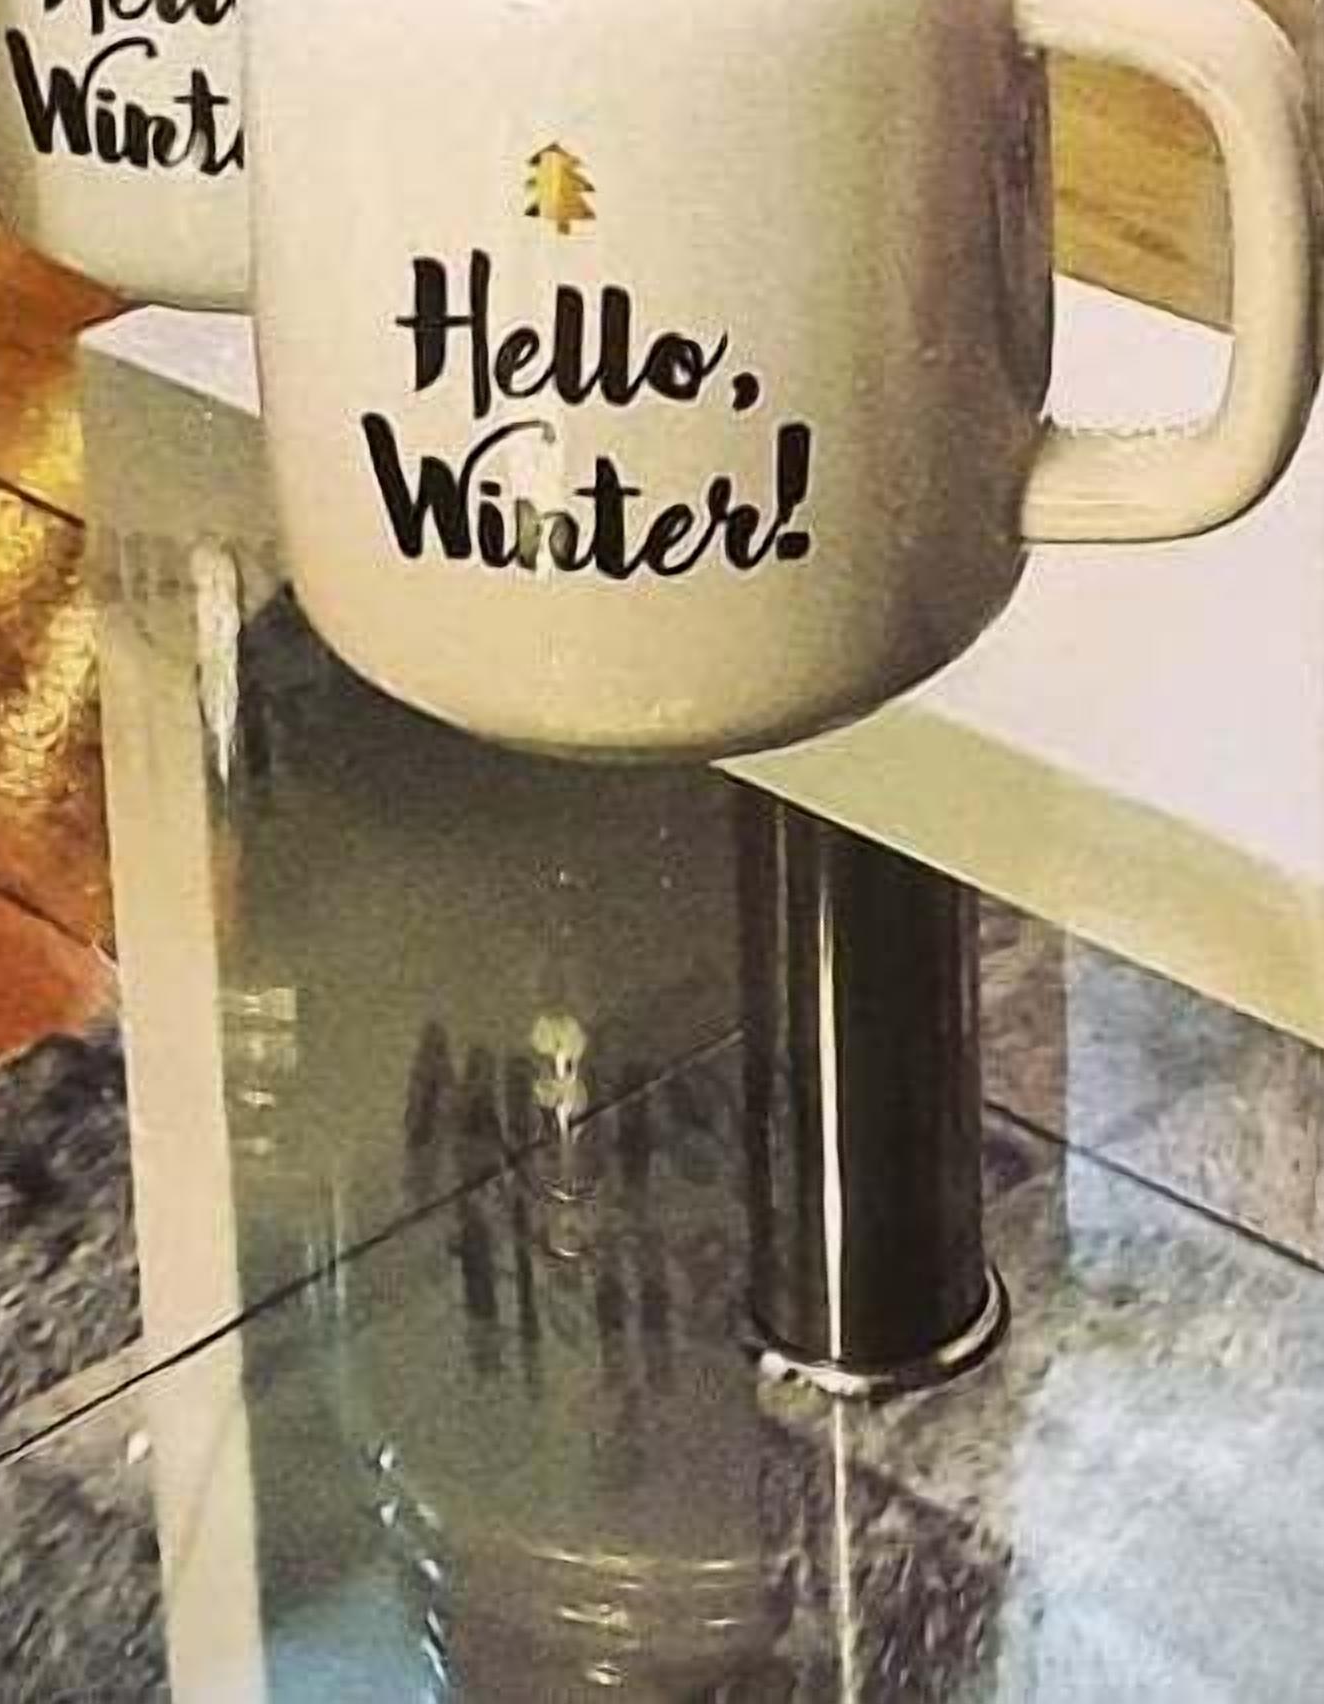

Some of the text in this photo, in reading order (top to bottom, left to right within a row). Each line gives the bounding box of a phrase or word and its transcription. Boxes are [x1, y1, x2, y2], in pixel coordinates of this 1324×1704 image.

[4, 27, 245, 176] Wint
[394, 248, 760, 420] Hello,
[361, 411, 812, 580] Winter!
